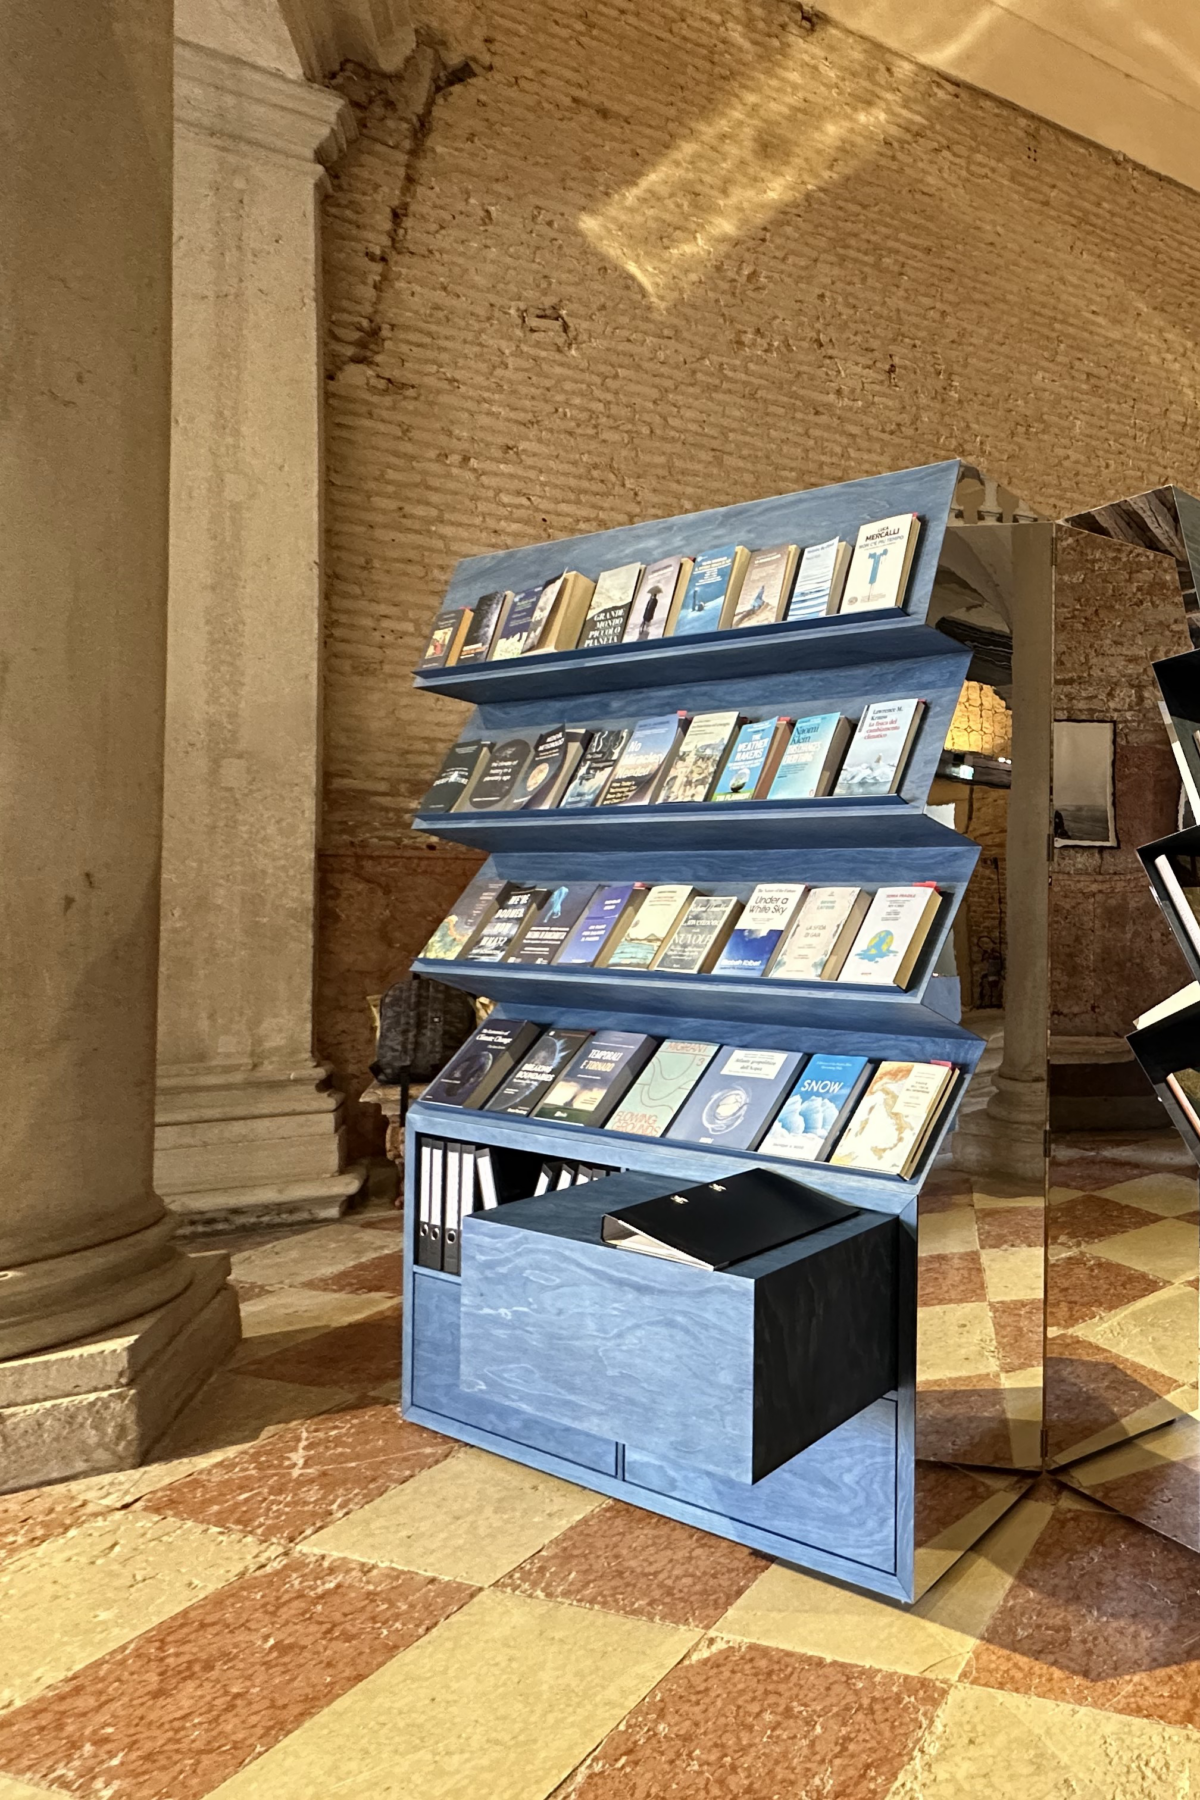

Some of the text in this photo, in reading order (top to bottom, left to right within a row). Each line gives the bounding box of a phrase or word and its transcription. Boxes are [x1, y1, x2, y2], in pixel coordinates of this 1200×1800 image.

[865, 528, 900, 542] MERCALLI
[887, 535, 904, 543] TEMPO
[593, 608, 625, 621] GRANDE
[595, 617, 623, 629] MONDO
[588, 627, 621, 638] PICCOLO
[583, 635, 618, 648] PIANETA
[796, 724, 820, 735] Naomi
[751, 733, 761, 741] THE
[791, 736, 811, 745] Klein
[628, 740, 642, 752] No
[737, 737, 769, 752] WEATHER
[622, 752, 664, 766] Miracles
[735, 749, 763, 762] MAKERS
[614, 766, 652, 779] Needed
[508, 894, 531, 905] WE'RE
[755, 896, 780, 905] Under
[749, 905, 788, 916] White Sky
[479, 936, 508, 947] WHAT?
[476, 1033, 513, 1044] Climate Change
[667, 1042, 708, 1053] MIGRANT
[588, 1049, 623, 1062] TEMPORALI
[586, 1062, 615, 1072] TORNADO
[695, 1057, 705, 1067] 3
[750, 1059, 776, 1067] geopolitico
[521, 1063, 554, 1073] BREAKING
[515, 1070, 555, 1082] BOUNDARIES
[801, 1079, 843, 1093] SNOW
[614, 1110, 657, 1125] FLOWING
[612, 1122, 661, 1137] GROUNDS
